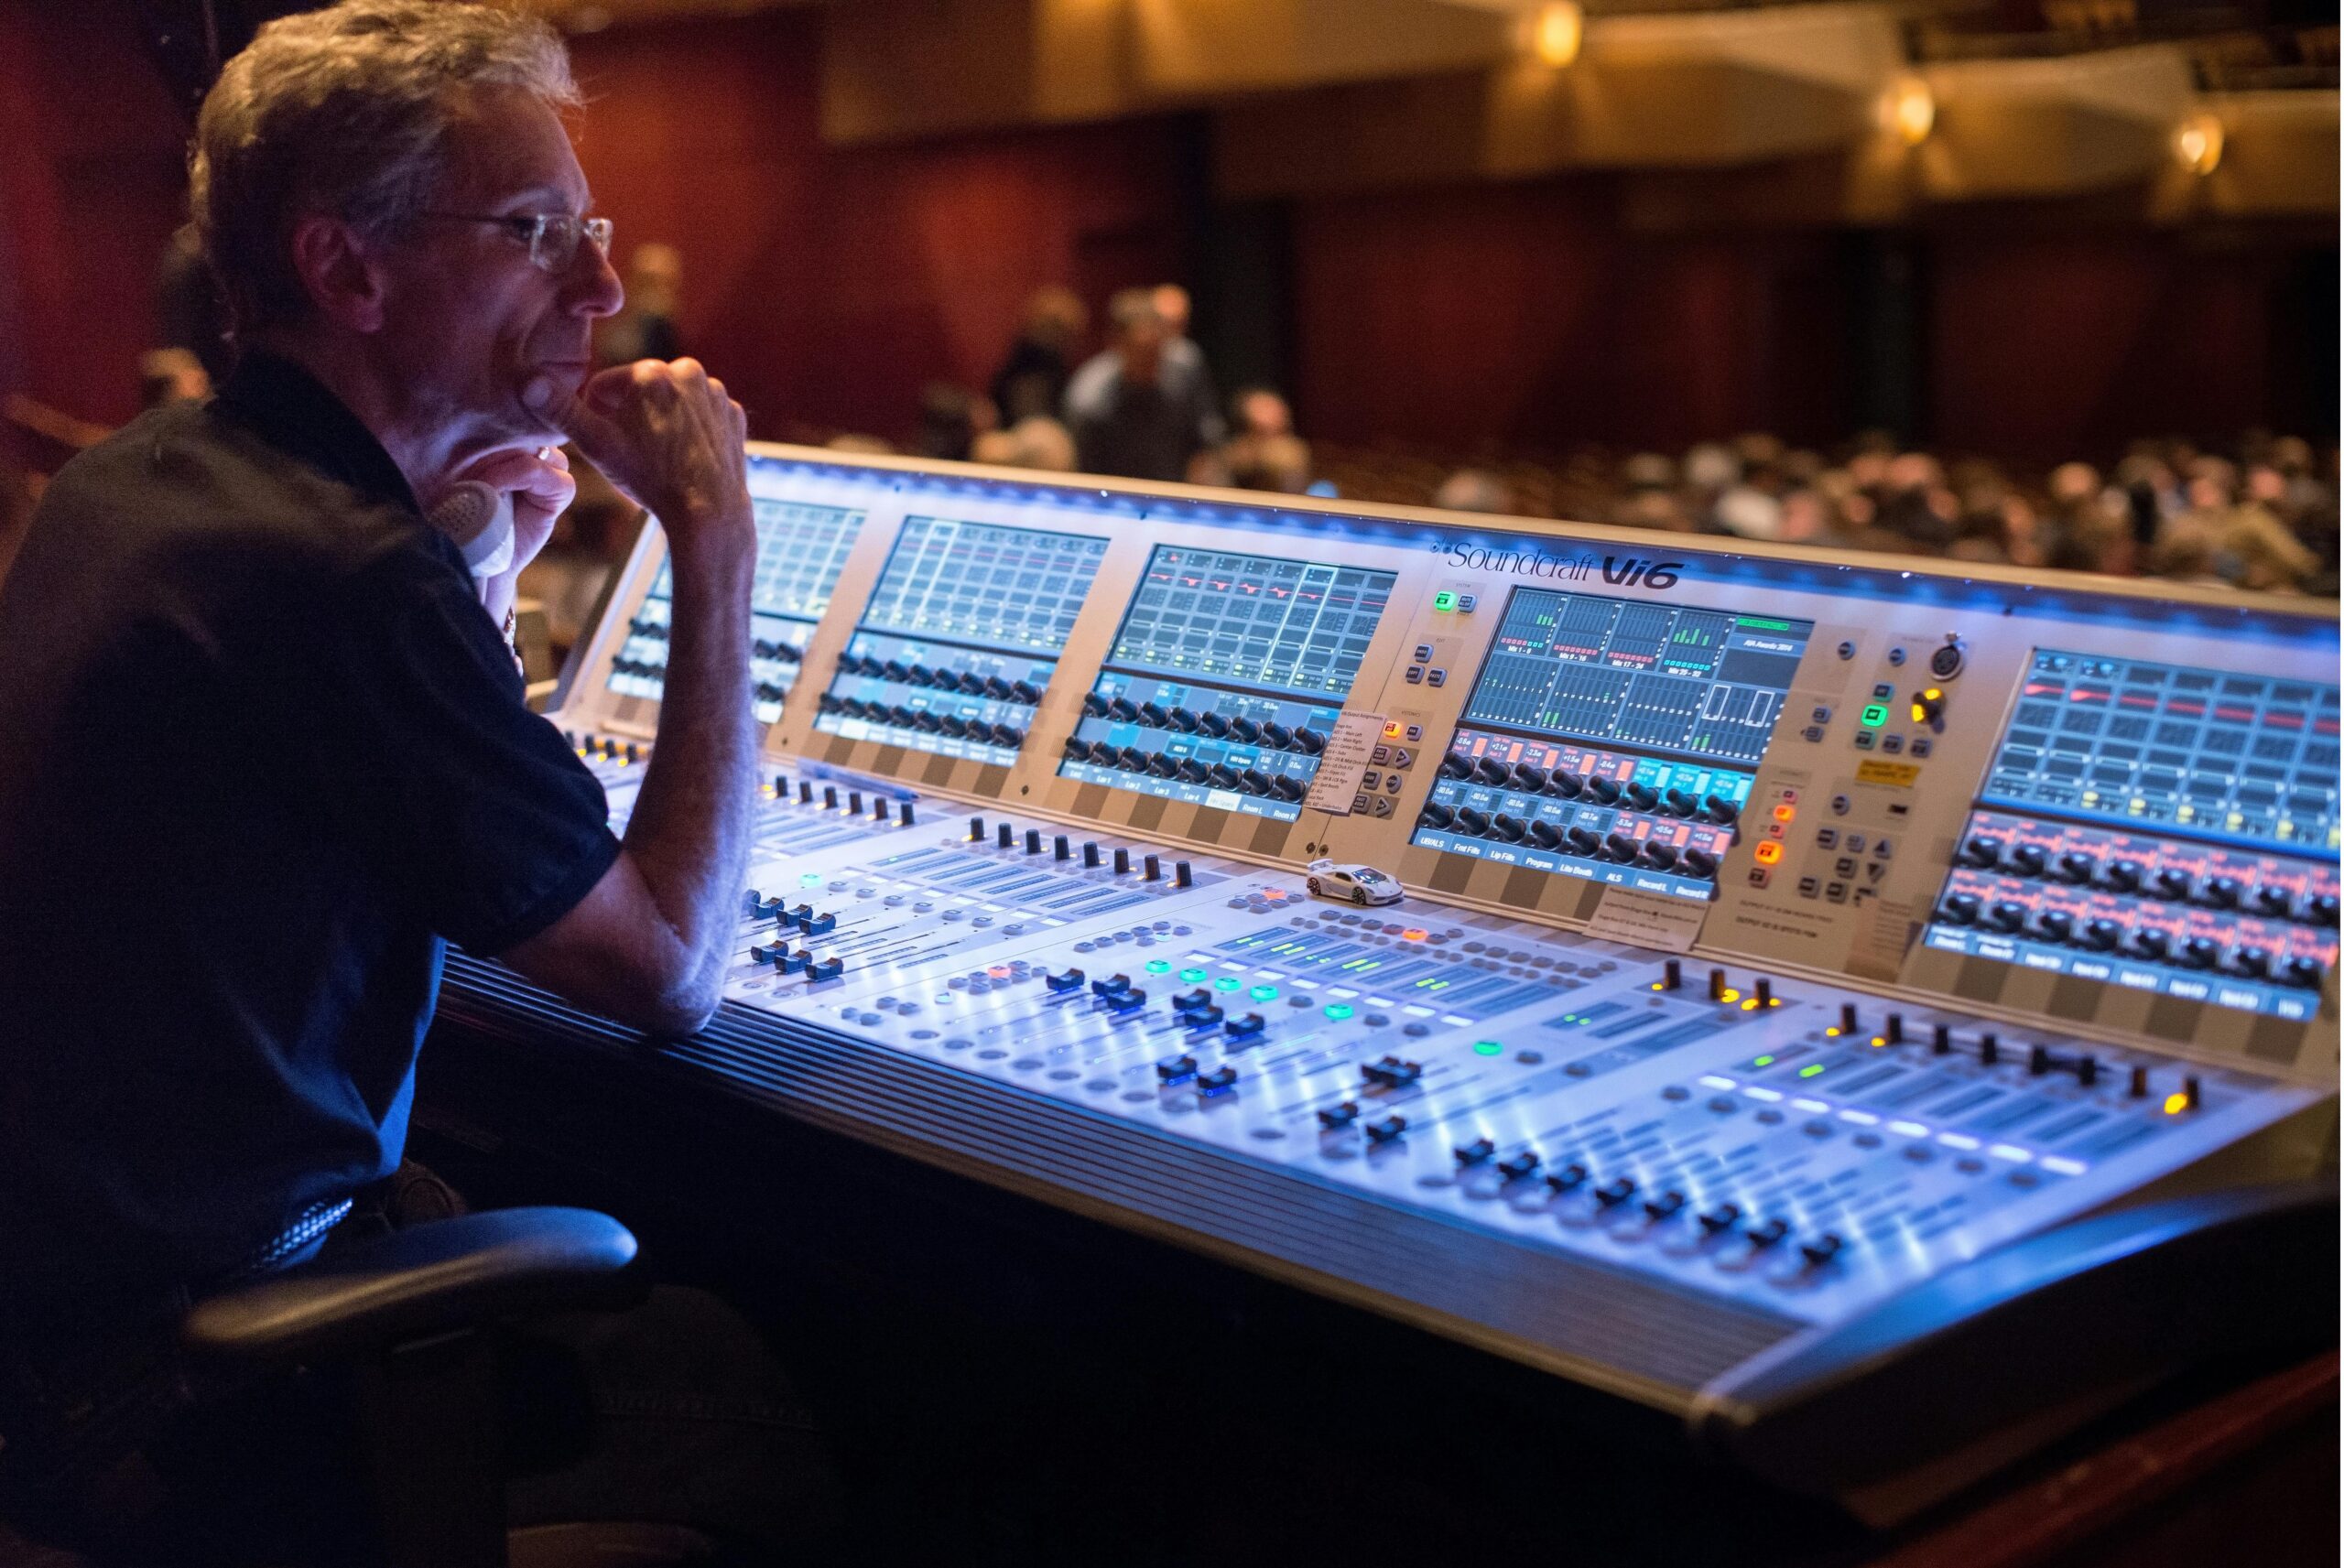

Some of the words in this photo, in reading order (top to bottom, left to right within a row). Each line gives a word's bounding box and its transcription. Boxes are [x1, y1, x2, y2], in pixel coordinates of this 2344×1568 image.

[1448, 542, 1594, 582] Soundcraft
[1601, 556, 1684, 589] Vi6
[1242, 803, 1257, 814] Room
[1273, 808, 1289, 819] Room
[1501, 851, 1515, 862] Fills
[1525, 857, 1554, 870] Program
[1606, 872, 1622, 882] ALS
